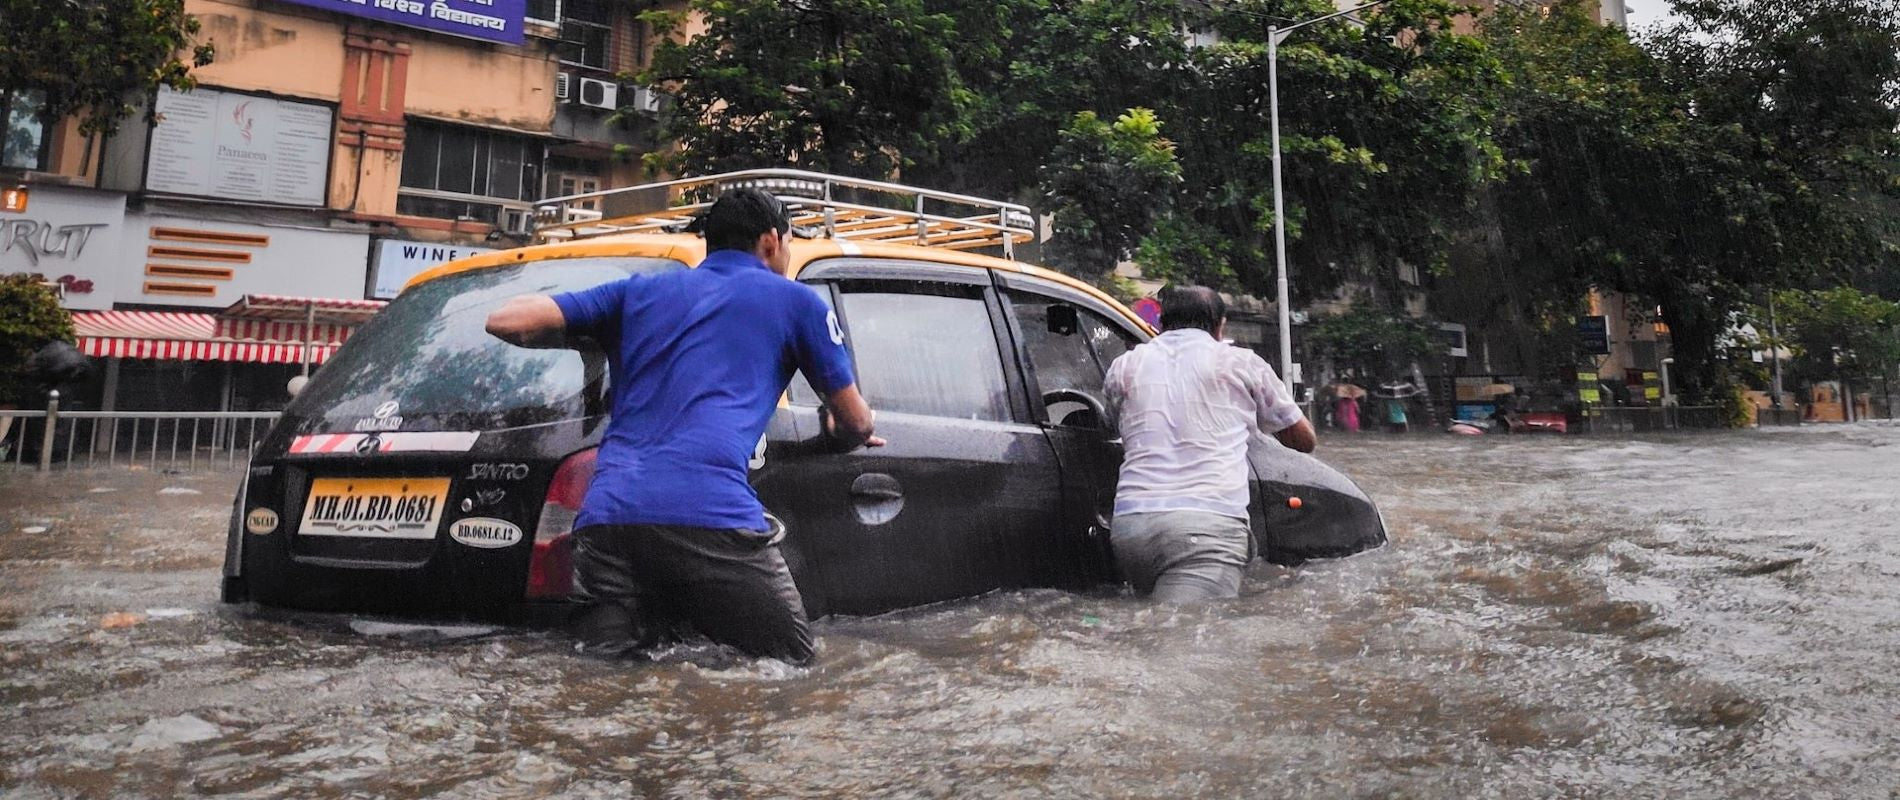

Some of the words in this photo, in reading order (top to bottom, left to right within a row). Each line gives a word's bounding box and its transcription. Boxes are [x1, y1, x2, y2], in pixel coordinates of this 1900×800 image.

[430, 2, 506, 31] विद्यालय
[217, 145, 268, 161] Panacea
[0, 218, 109, 267] RUT
[403, 245, 457, 261] WINE
[465, 462, 530, 480] SANTRO
[309, 494, 437, 523] MH.01.BD.0681
